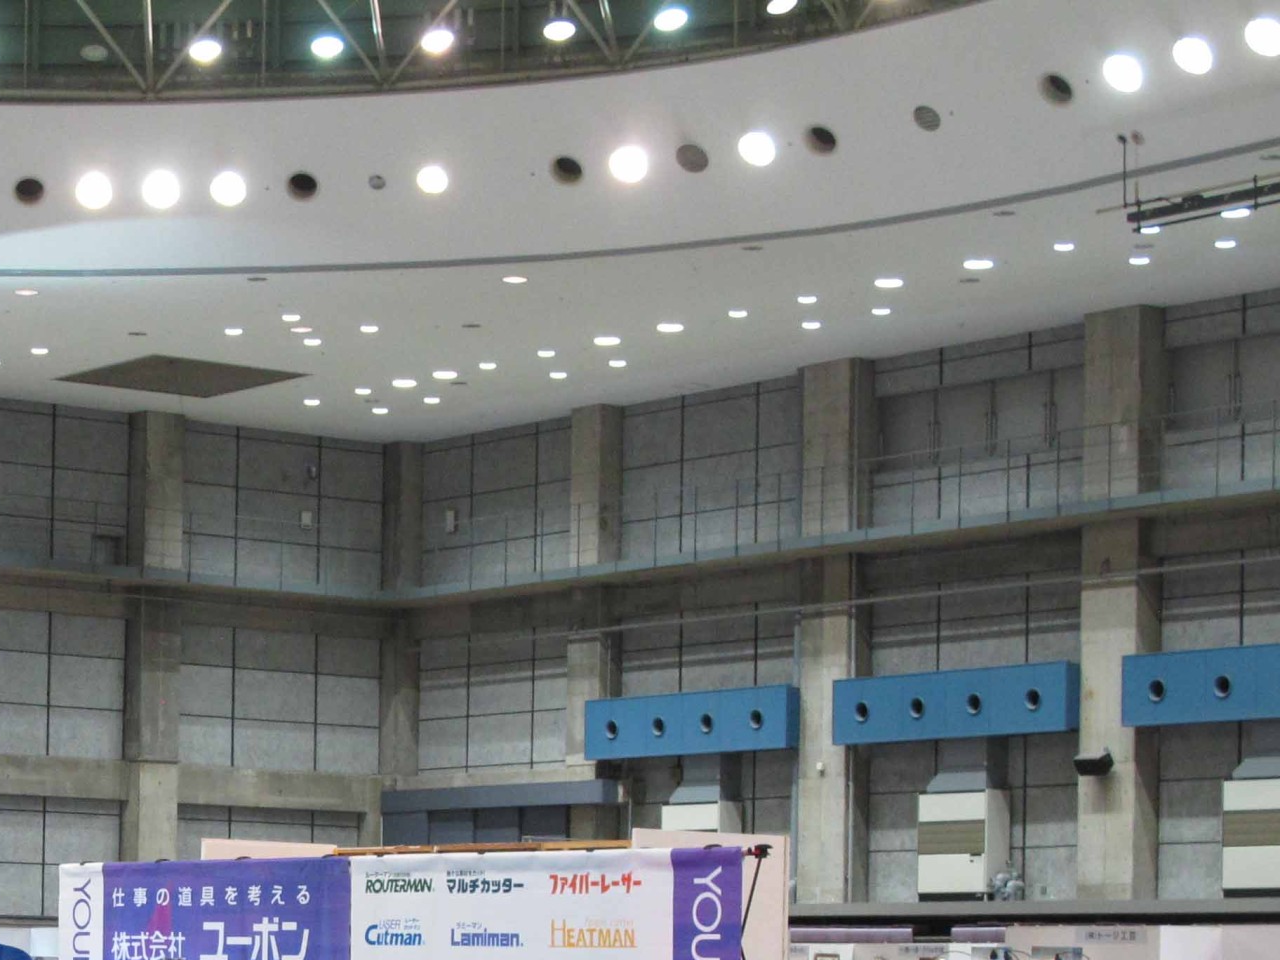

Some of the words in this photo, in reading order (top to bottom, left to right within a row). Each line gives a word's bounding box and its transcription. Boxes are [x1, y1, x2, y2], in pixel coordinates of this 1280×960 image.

[365, 878, 434, 894] ROUTERMAN
[446, 877, 524, 894] マルチカッター
[549, 870, 642, 895] ファイバーレーザー
[112, 884, 311, 908] 仕事の道具を考える
[365, 924, 422, 946] Cutman
[549, 918, 636, 948] HEATMAN
